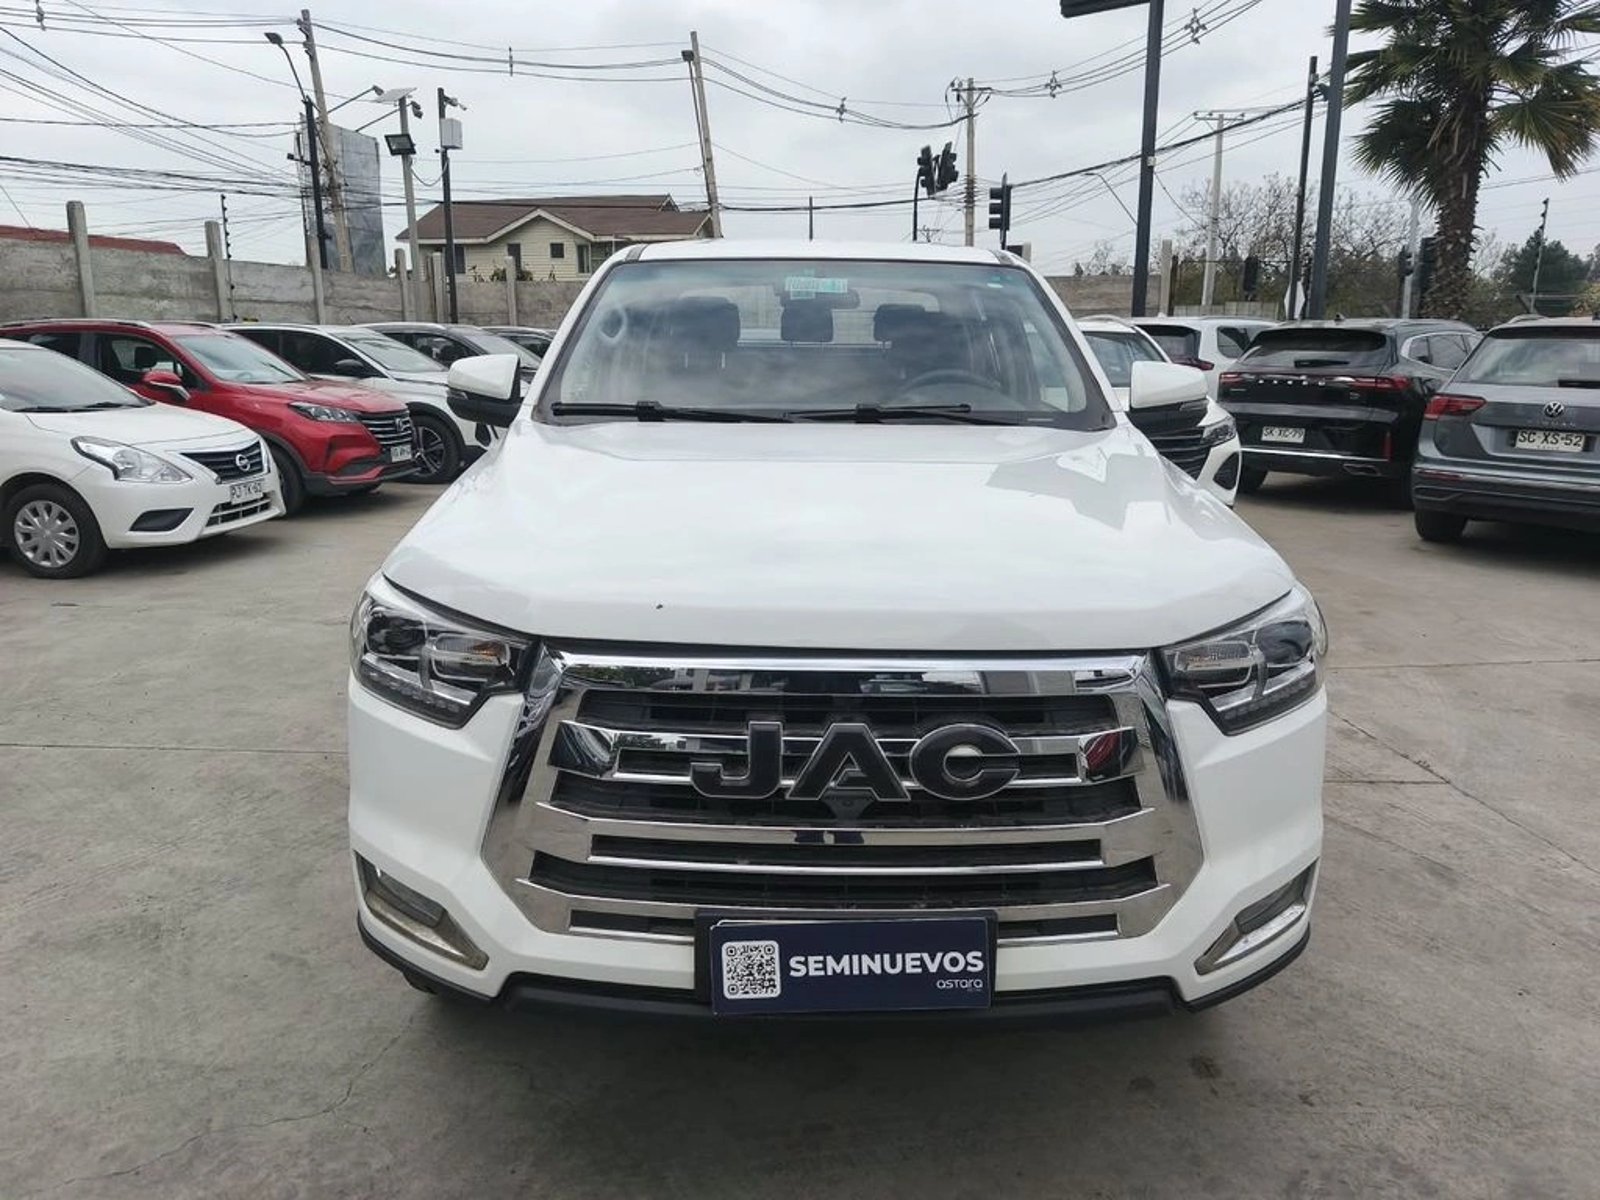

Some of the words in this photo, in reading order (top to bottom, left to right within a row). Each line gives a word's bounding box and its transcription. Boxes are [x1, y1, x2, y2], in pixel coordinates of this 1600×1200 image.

[690, 721, 1020, 801] JAC
[789, 951, 984, 977] SEMINUEVOS
[936, 979, 983, 989] astara
